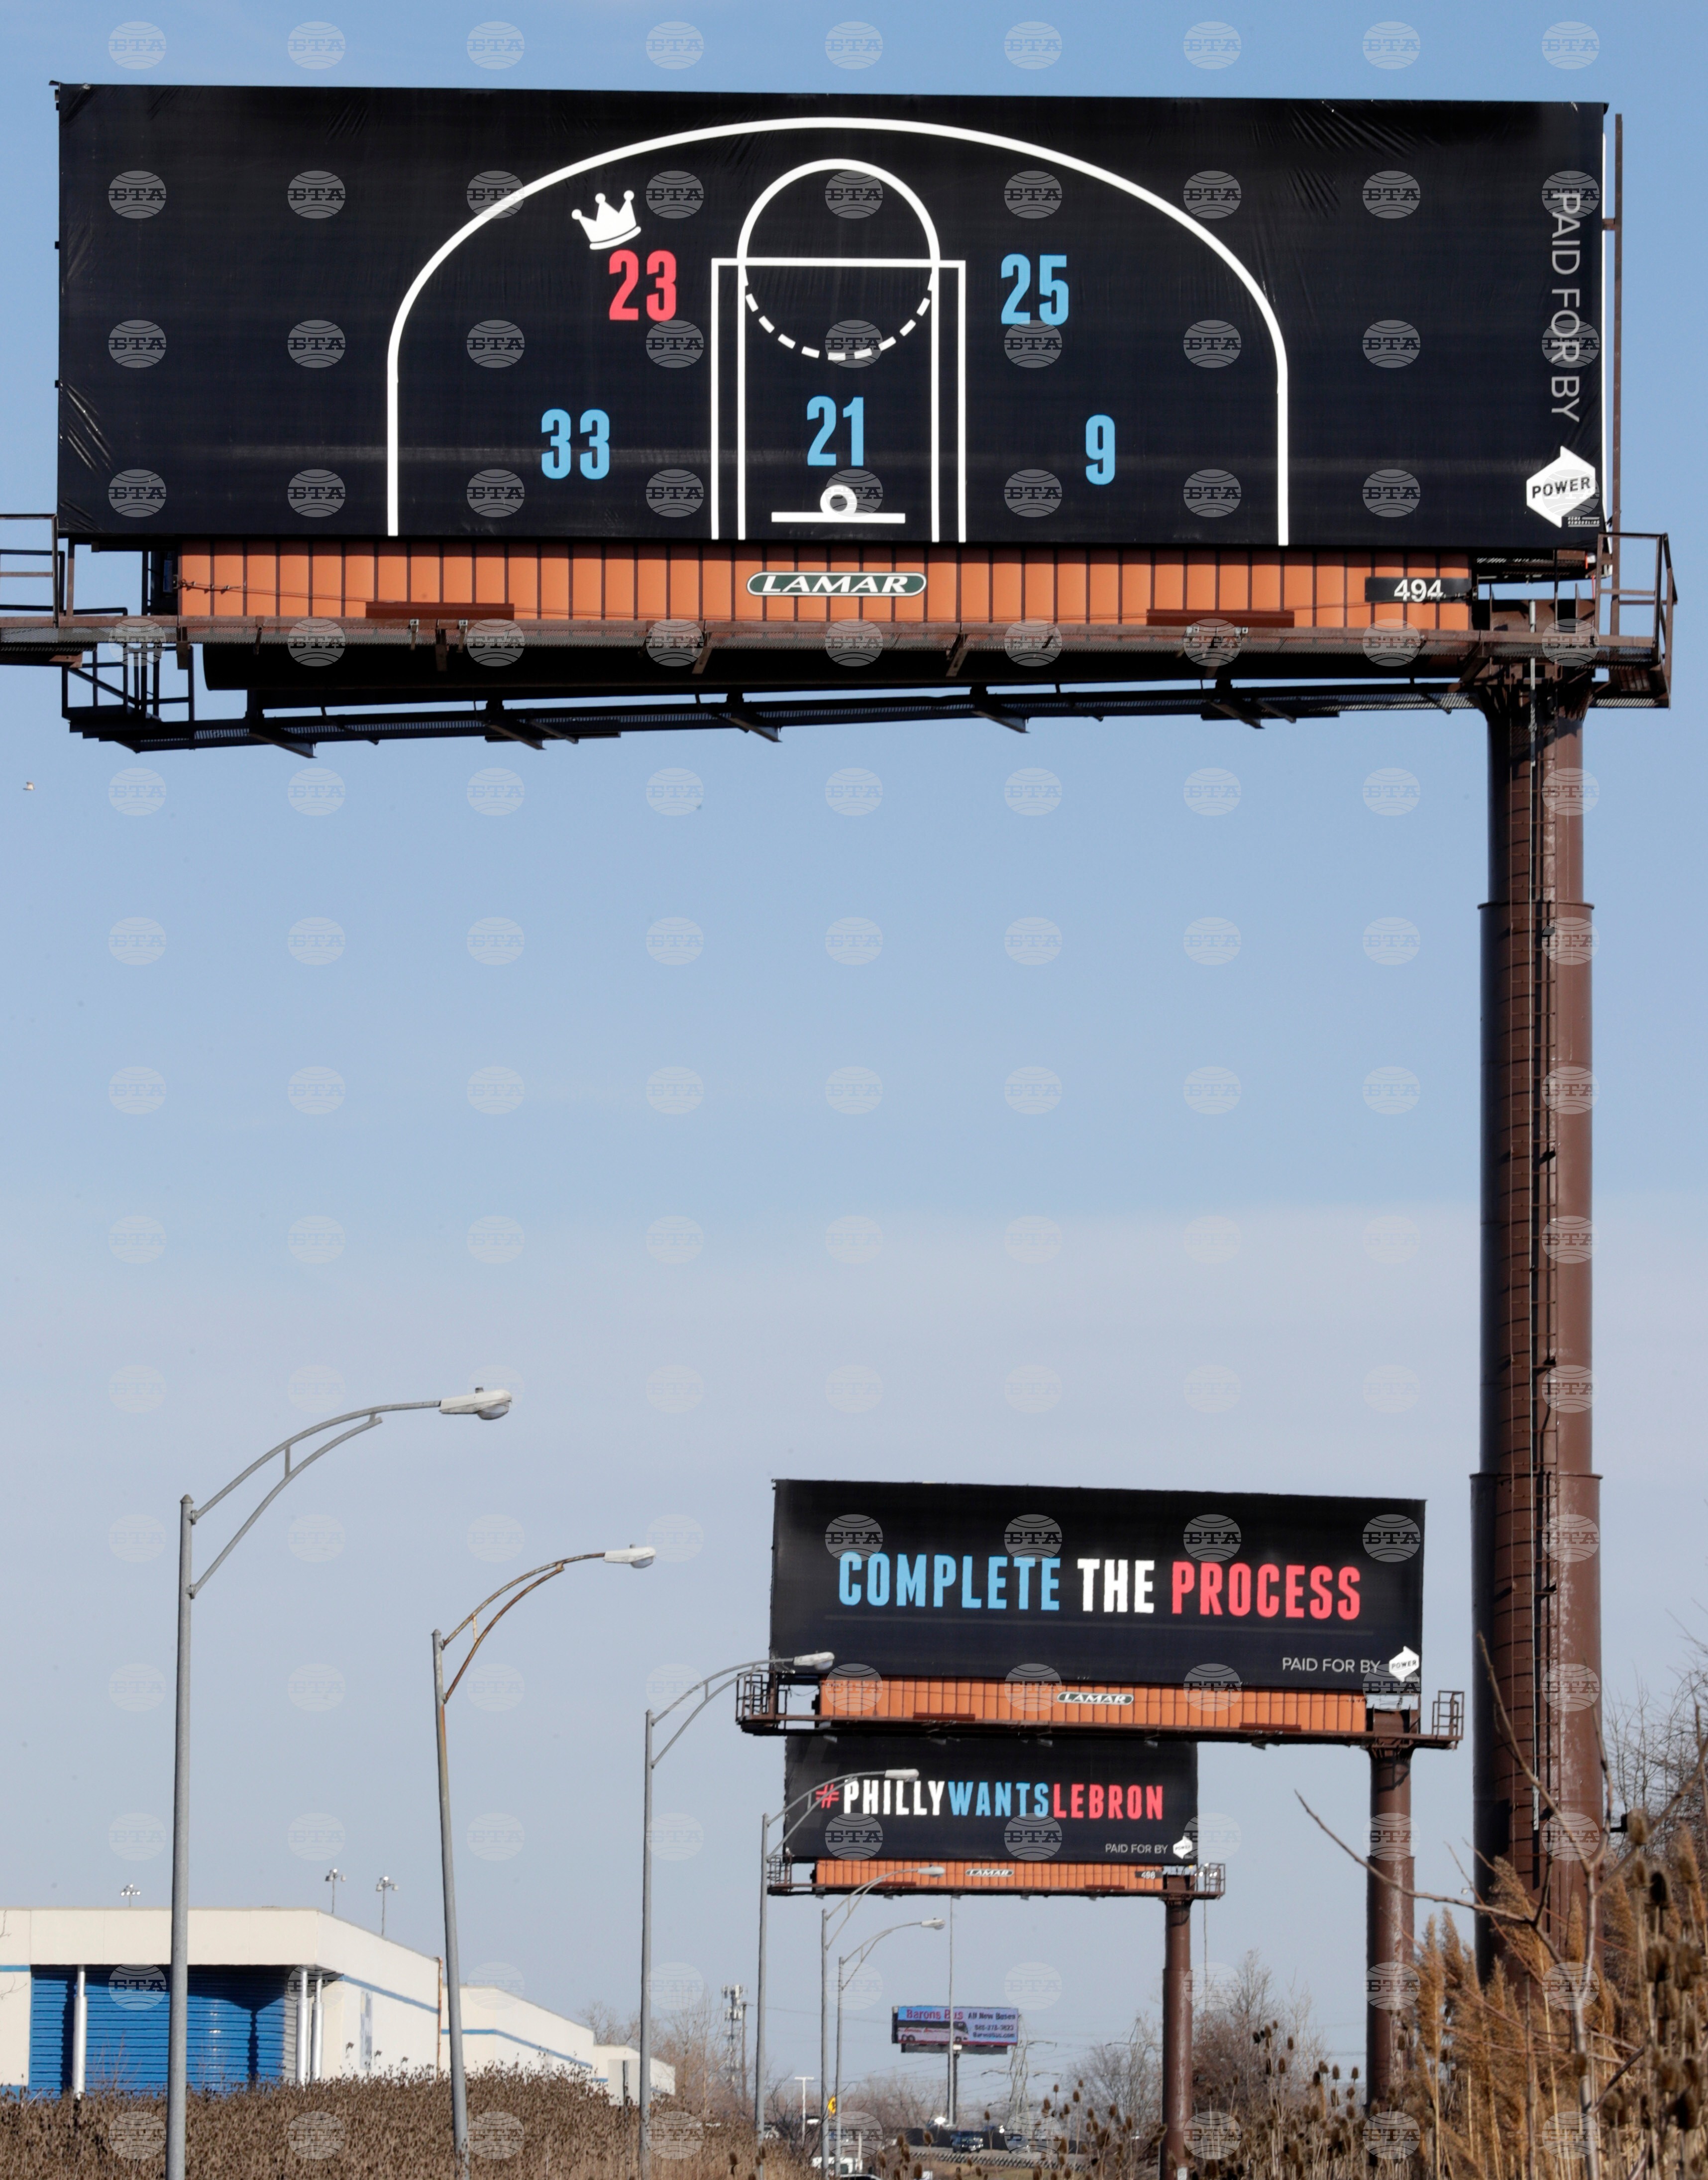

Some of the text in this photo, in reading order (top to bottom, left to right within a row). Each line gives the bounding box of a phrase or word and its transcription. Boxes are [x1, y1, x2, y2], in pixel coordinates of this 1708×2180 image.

[609, 249, 677, 322] 23
[1001, 253, 1069, 326] 25
[1551, 193, 1581, 422] PAID FOR BY
[541, 409, 610, 480] 33
[807, 395, 864, 466] 21
[1085, 414, 1115, 485] 9
[1532, 477, 1591, 499] POWER
[762, 575, 908, 593] LAMAR
[1394, 579, 1444, 602] 494
[839, 1551, 1361, 1621] COMPLETE THE PROCESS
[1282, 1657, 1381, 1673] PAID FOR BY
[1390, 1660, 1417, 1669] POWER
[1064, 1693, 1126, 1704] LAMAR
[815, 1779, 1163, 1820] #PHILLYWANTSLEBRON
[1105, 1843, 1169, 1854] PAID FOR BY
[906, 2009, 941, 2020] Barons
